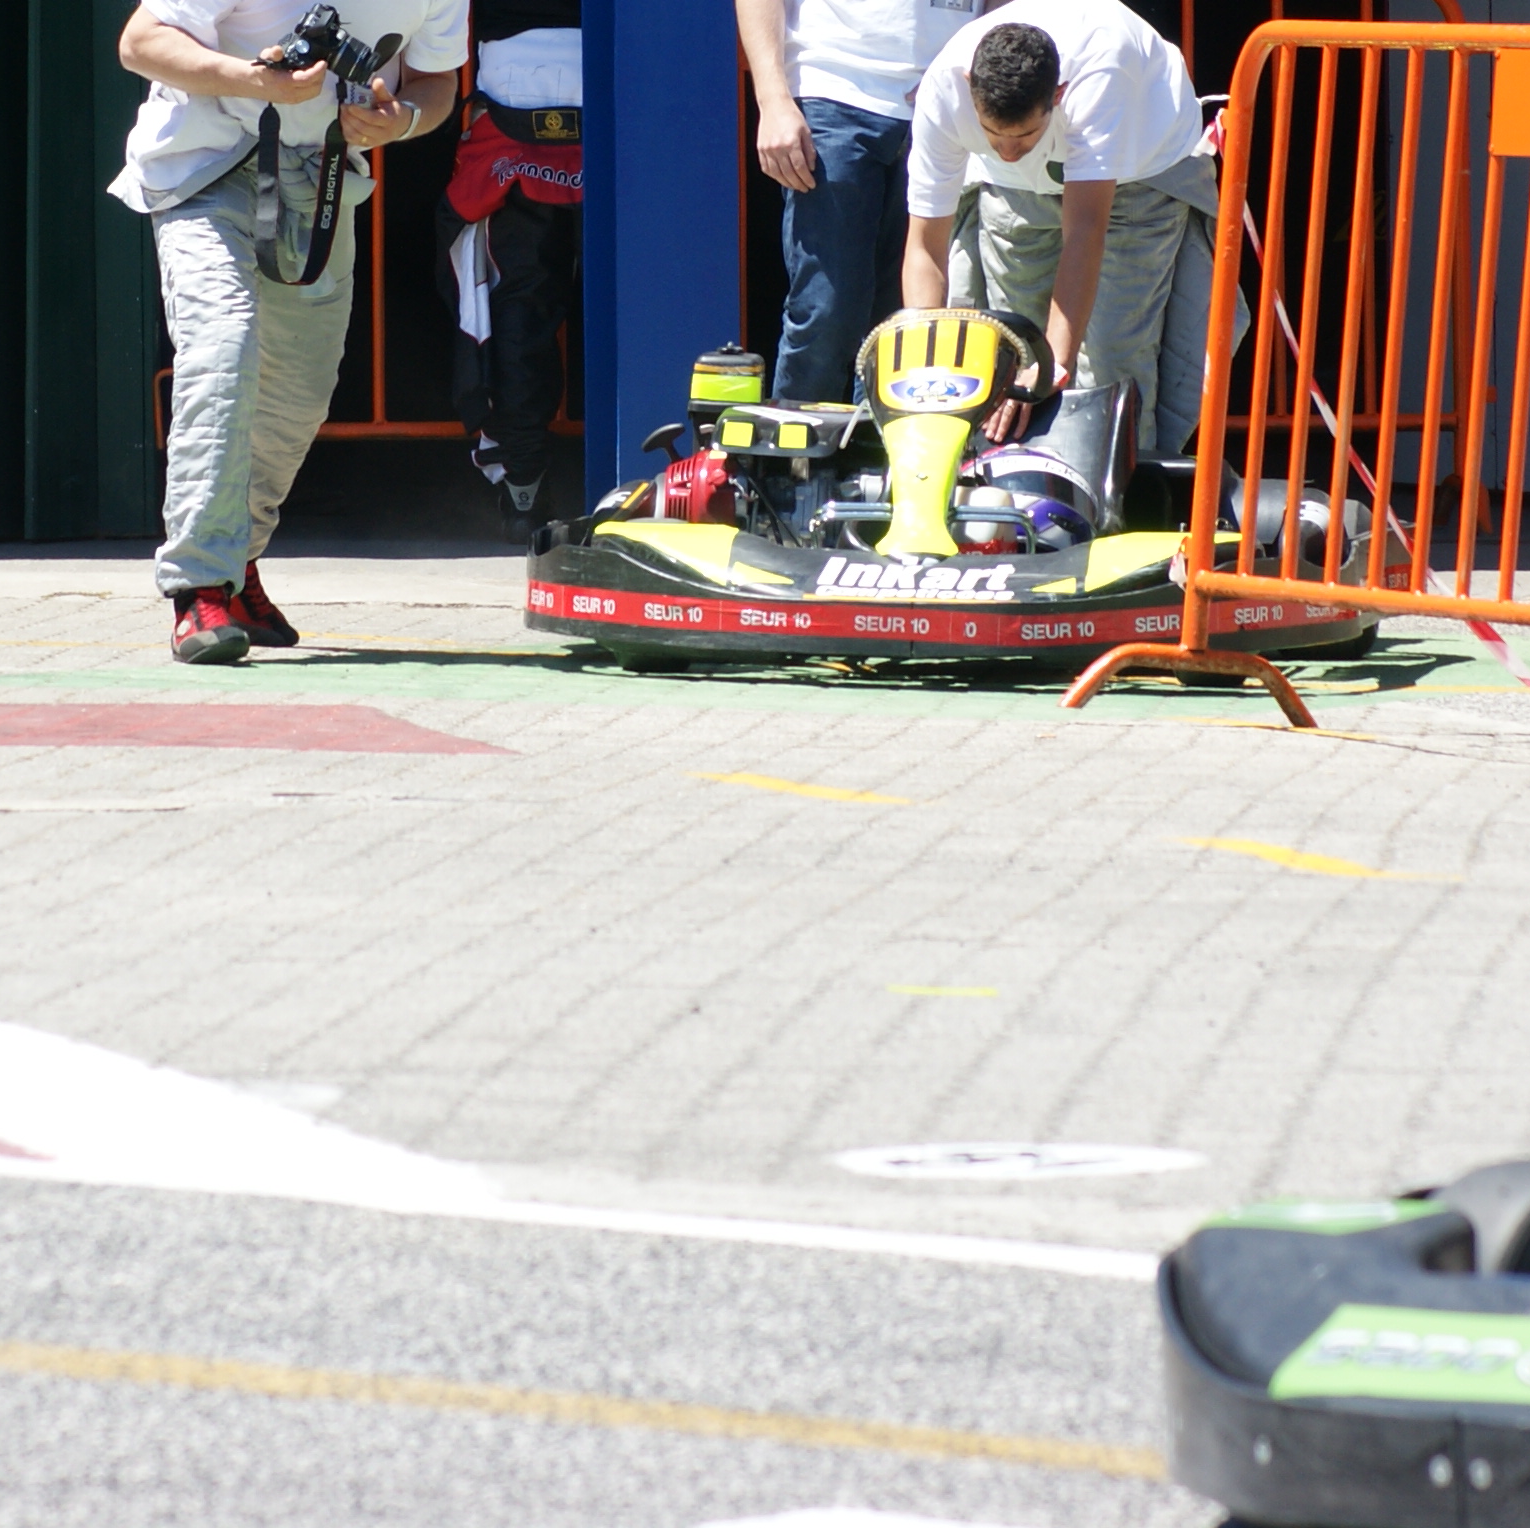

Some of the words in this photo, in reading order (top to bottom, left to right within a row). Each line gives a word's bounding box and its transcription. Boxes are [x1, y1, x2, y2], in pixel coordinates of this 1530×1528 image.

[325, 153, 340, 201] DIGITAL
[320, 204, 334, 230] EOS
[572, 596, 601, 614] SEUR
[602, 598, 616, 615] 10
[644, 602, 683, 622] SEUR
[687, 605, 703, 623] 10
[1234, 605, 1270, 625] SEUR
[1271, 604, 1284, 621] 10
[739, 609, 788, 628] SEUR
[793, 613, 811, 629] 10
[854, 615, 906, 633] SEUR
[910, 618, 930, 635] 10
[1134, 613, 1180, 633] SEUR
[1021, 623, 1072, 640] SEUR
[1077, 621, 1095, 638] 10
